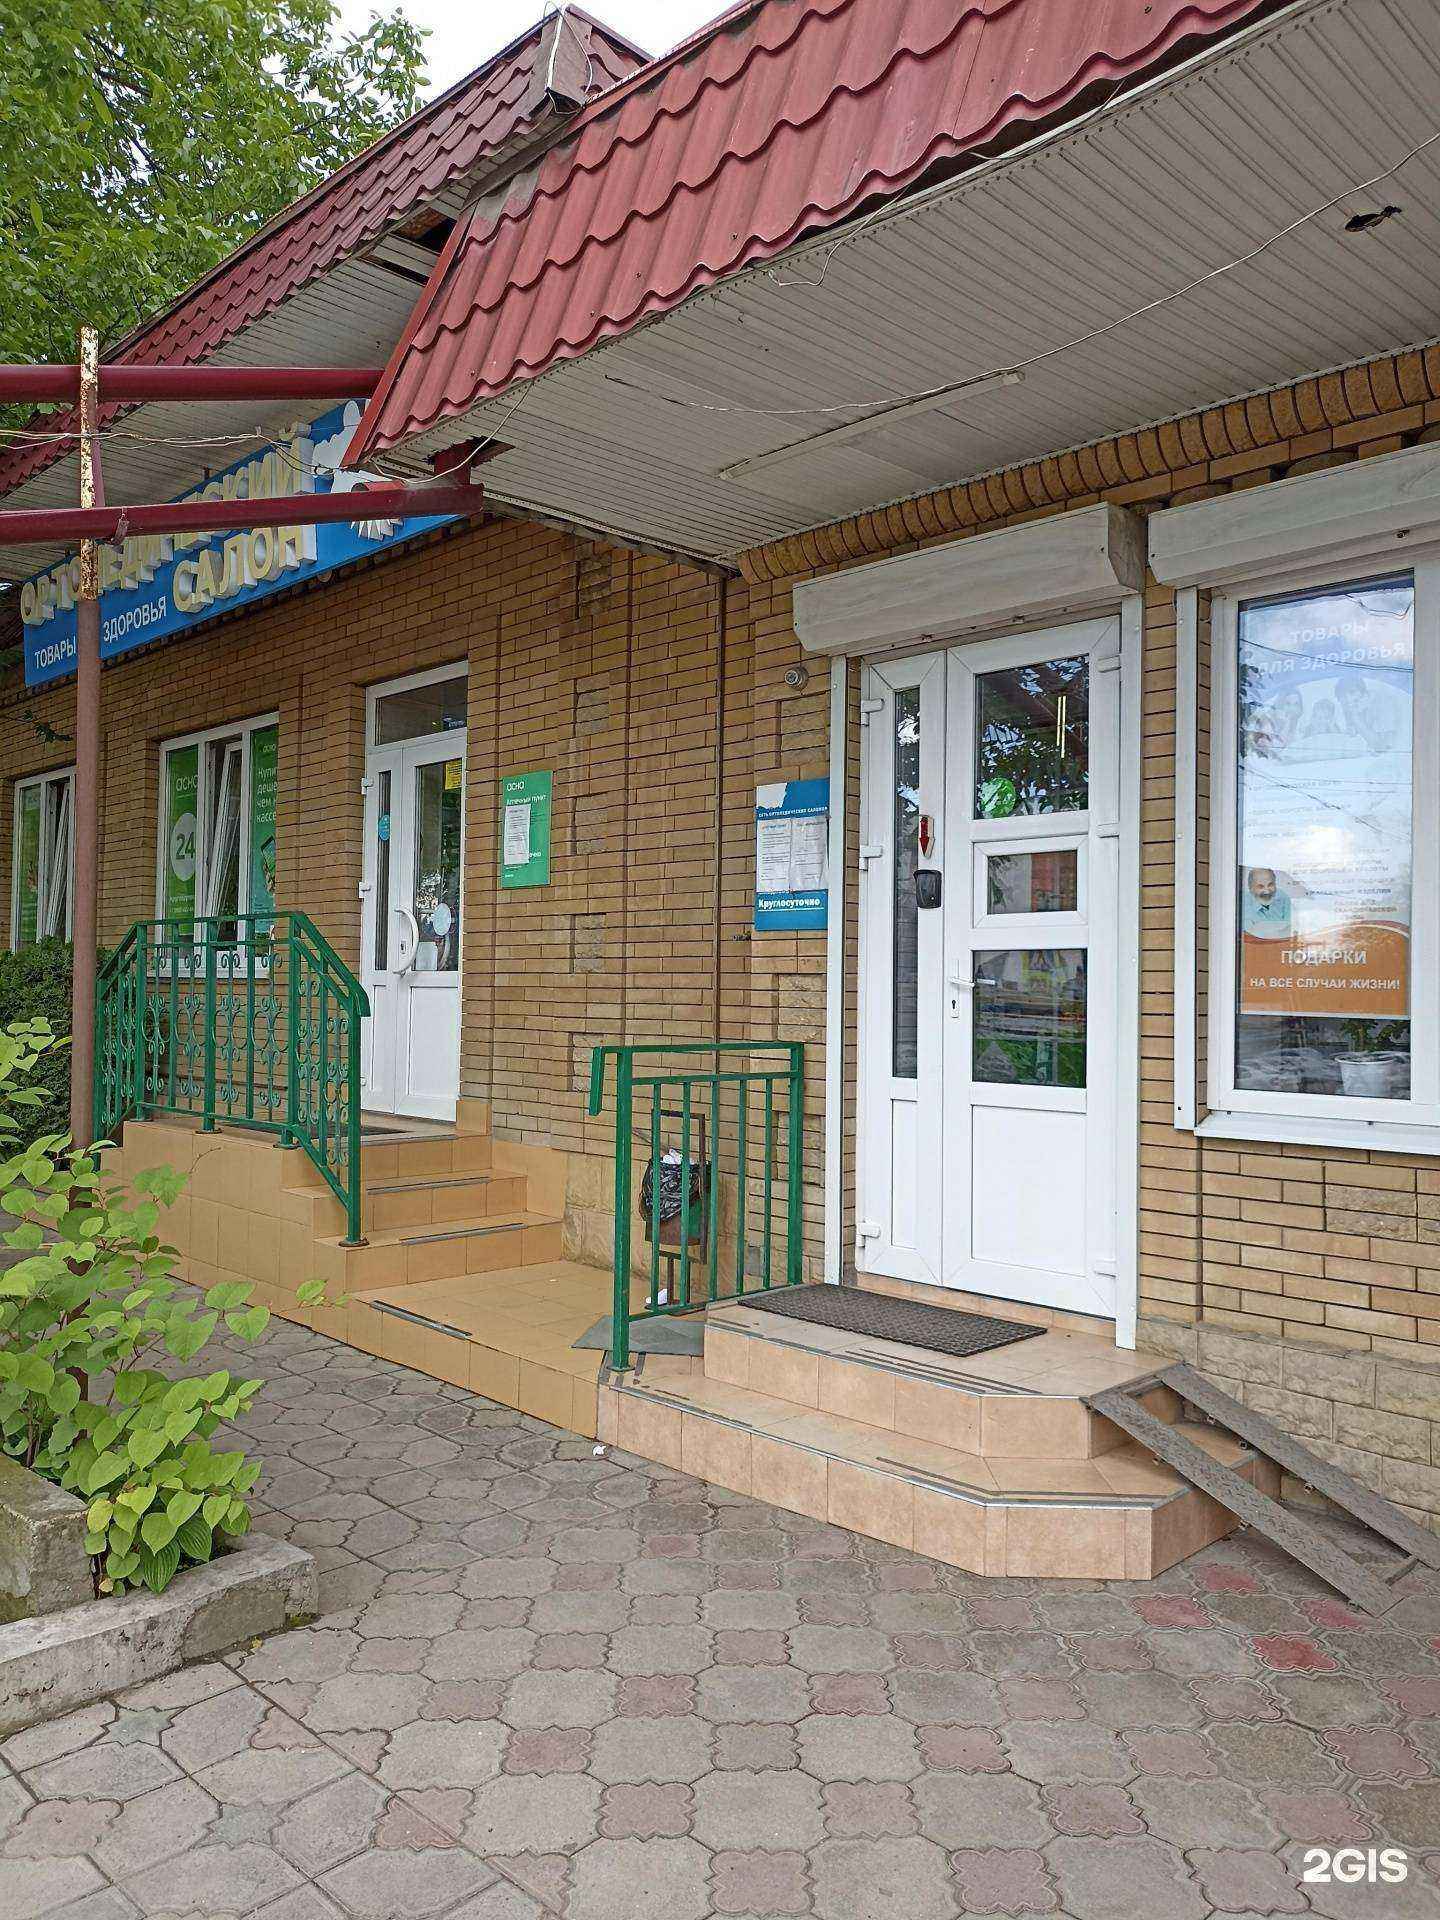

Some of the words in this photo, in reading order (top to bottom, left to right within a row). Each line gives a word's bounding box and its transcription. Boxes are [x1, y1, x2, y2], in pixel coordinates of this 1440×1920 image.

[173, 526, 317, 614] САЛОН
[34, 635, 77, 669] ТОВАРЫ
[103, 595, 167, 643] ЗДОРОВЬЯ
[1290, 621, 1369, 643] ТОВАРЫ
[1300, 642, 1406, 671] ЗДОРОВЬЯ
[175, 831, 195, 860] 24
[758, 898, 821, 909] Круглосуточно
[1280, 950, 1367, 965] ПОДАРКИ
[1250, 978, 1266, 987] НА
[1269, 978, 1294, 988] ВСЕ
[1296, 979, 1346, 988] СЛУЧАИ
[1350, 979, 1400, 990] ЖИЗНИ!
